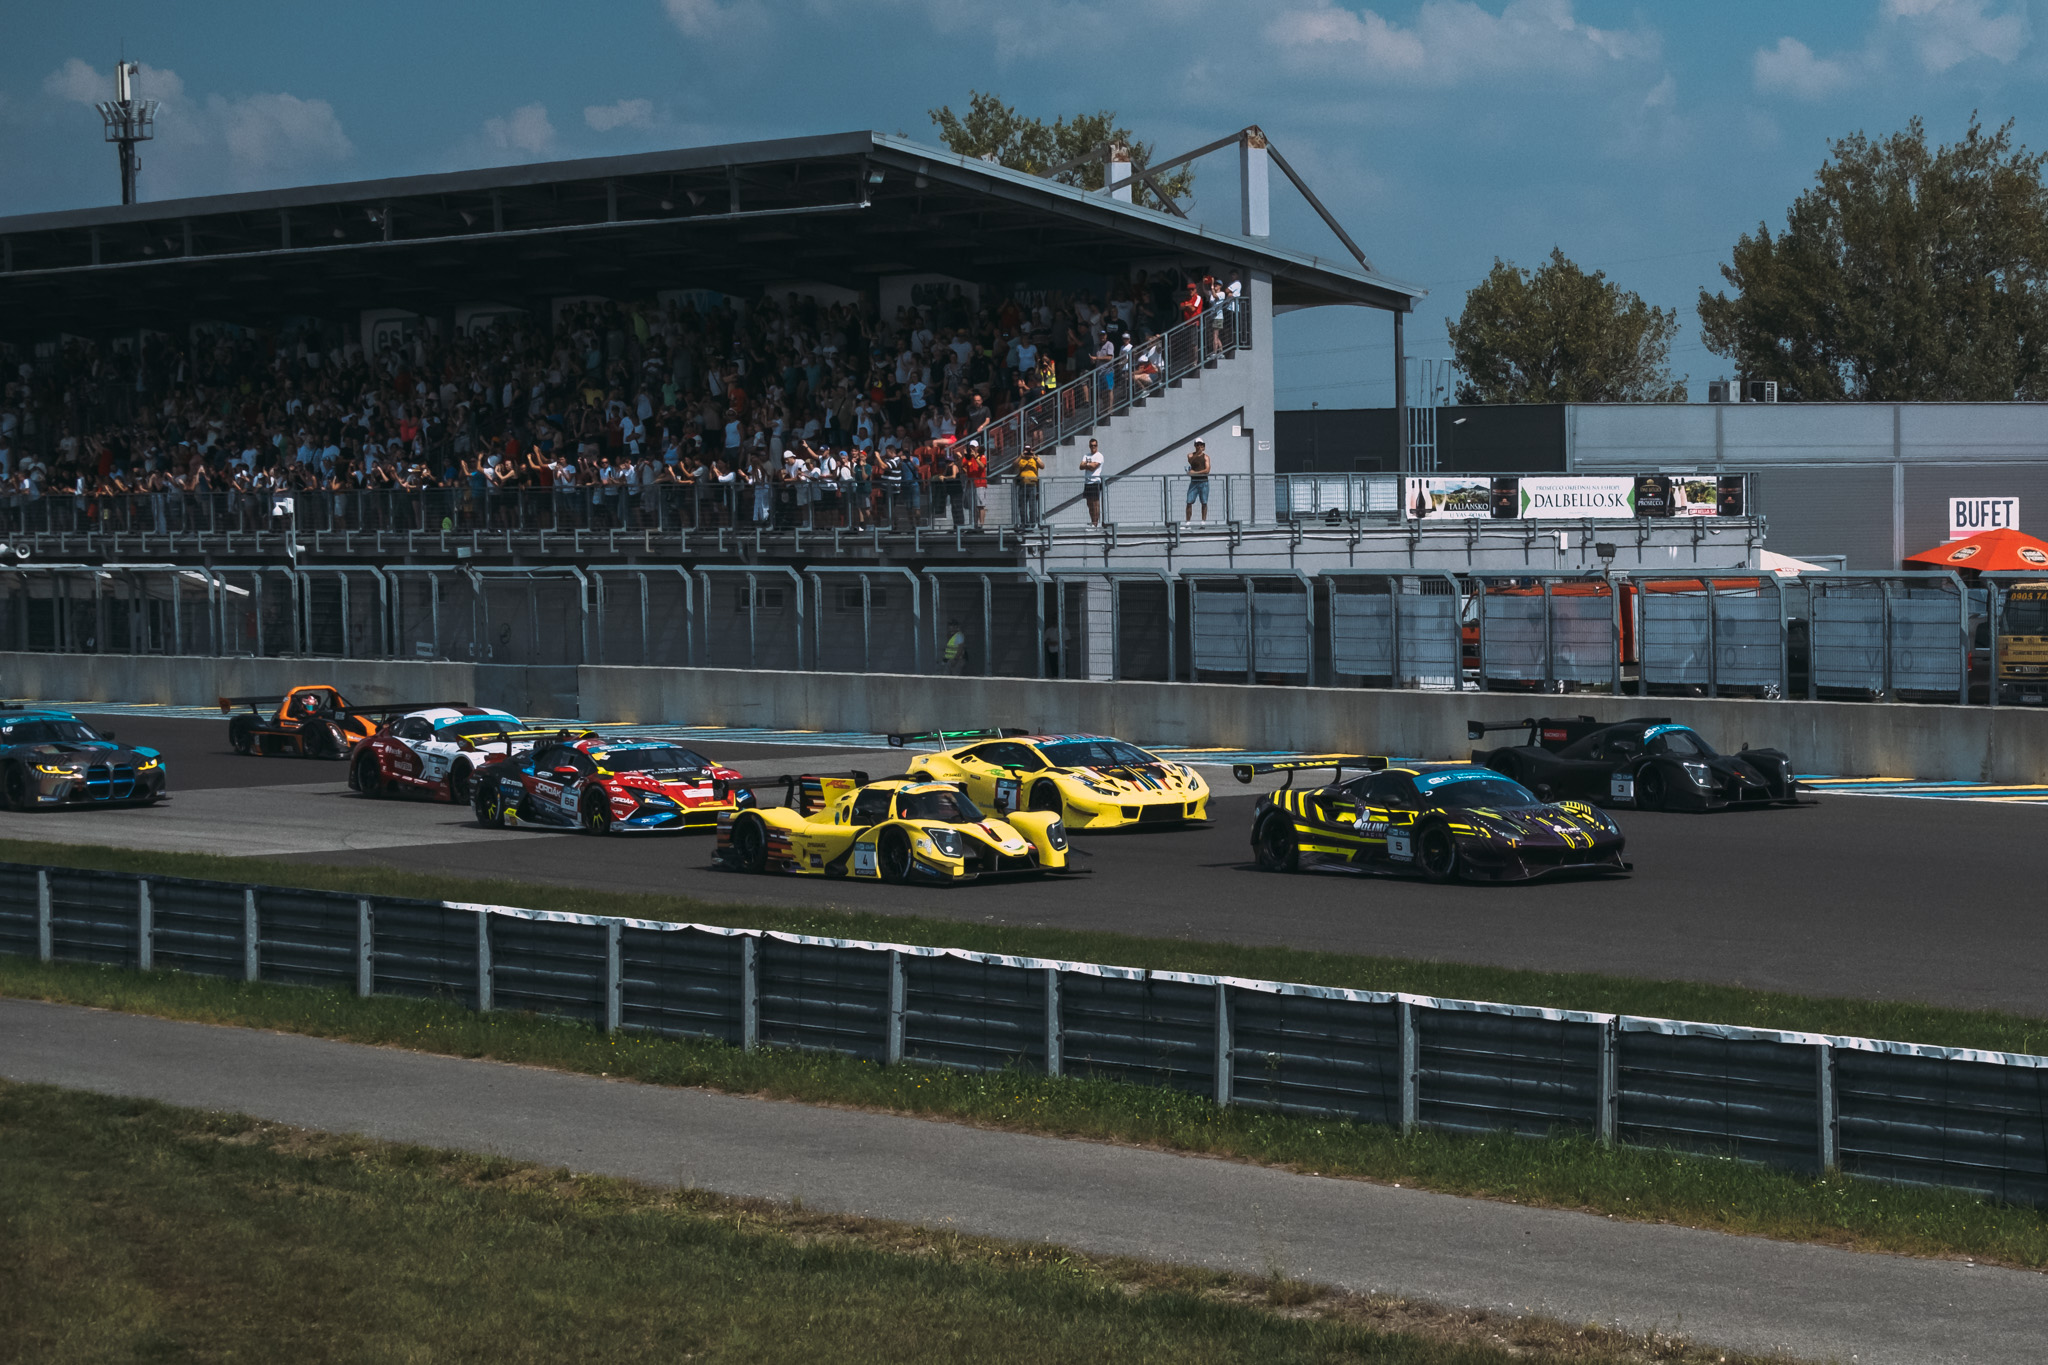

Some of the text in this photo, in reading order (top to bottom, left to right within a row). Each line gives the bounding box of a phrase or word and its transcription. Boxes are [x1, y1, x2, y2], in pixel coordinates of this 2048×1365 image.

[1534, 493, 1624, 508] DALBELLO.SK
[1448, 503, 1489, 511] TALIANSKO
[1956, 500, 2014, 527] BUFET
[2011, 591, 2048, 601] 0905 74
[1, 726, 14, 735] 16
[434, 766, 442, 775] 2
[1618, 784, 1625, 793] 3
[565, 797, 575, 807] 66
[1395, 842, 1403, 851] 5
[863, 854, 868, 866] 4
